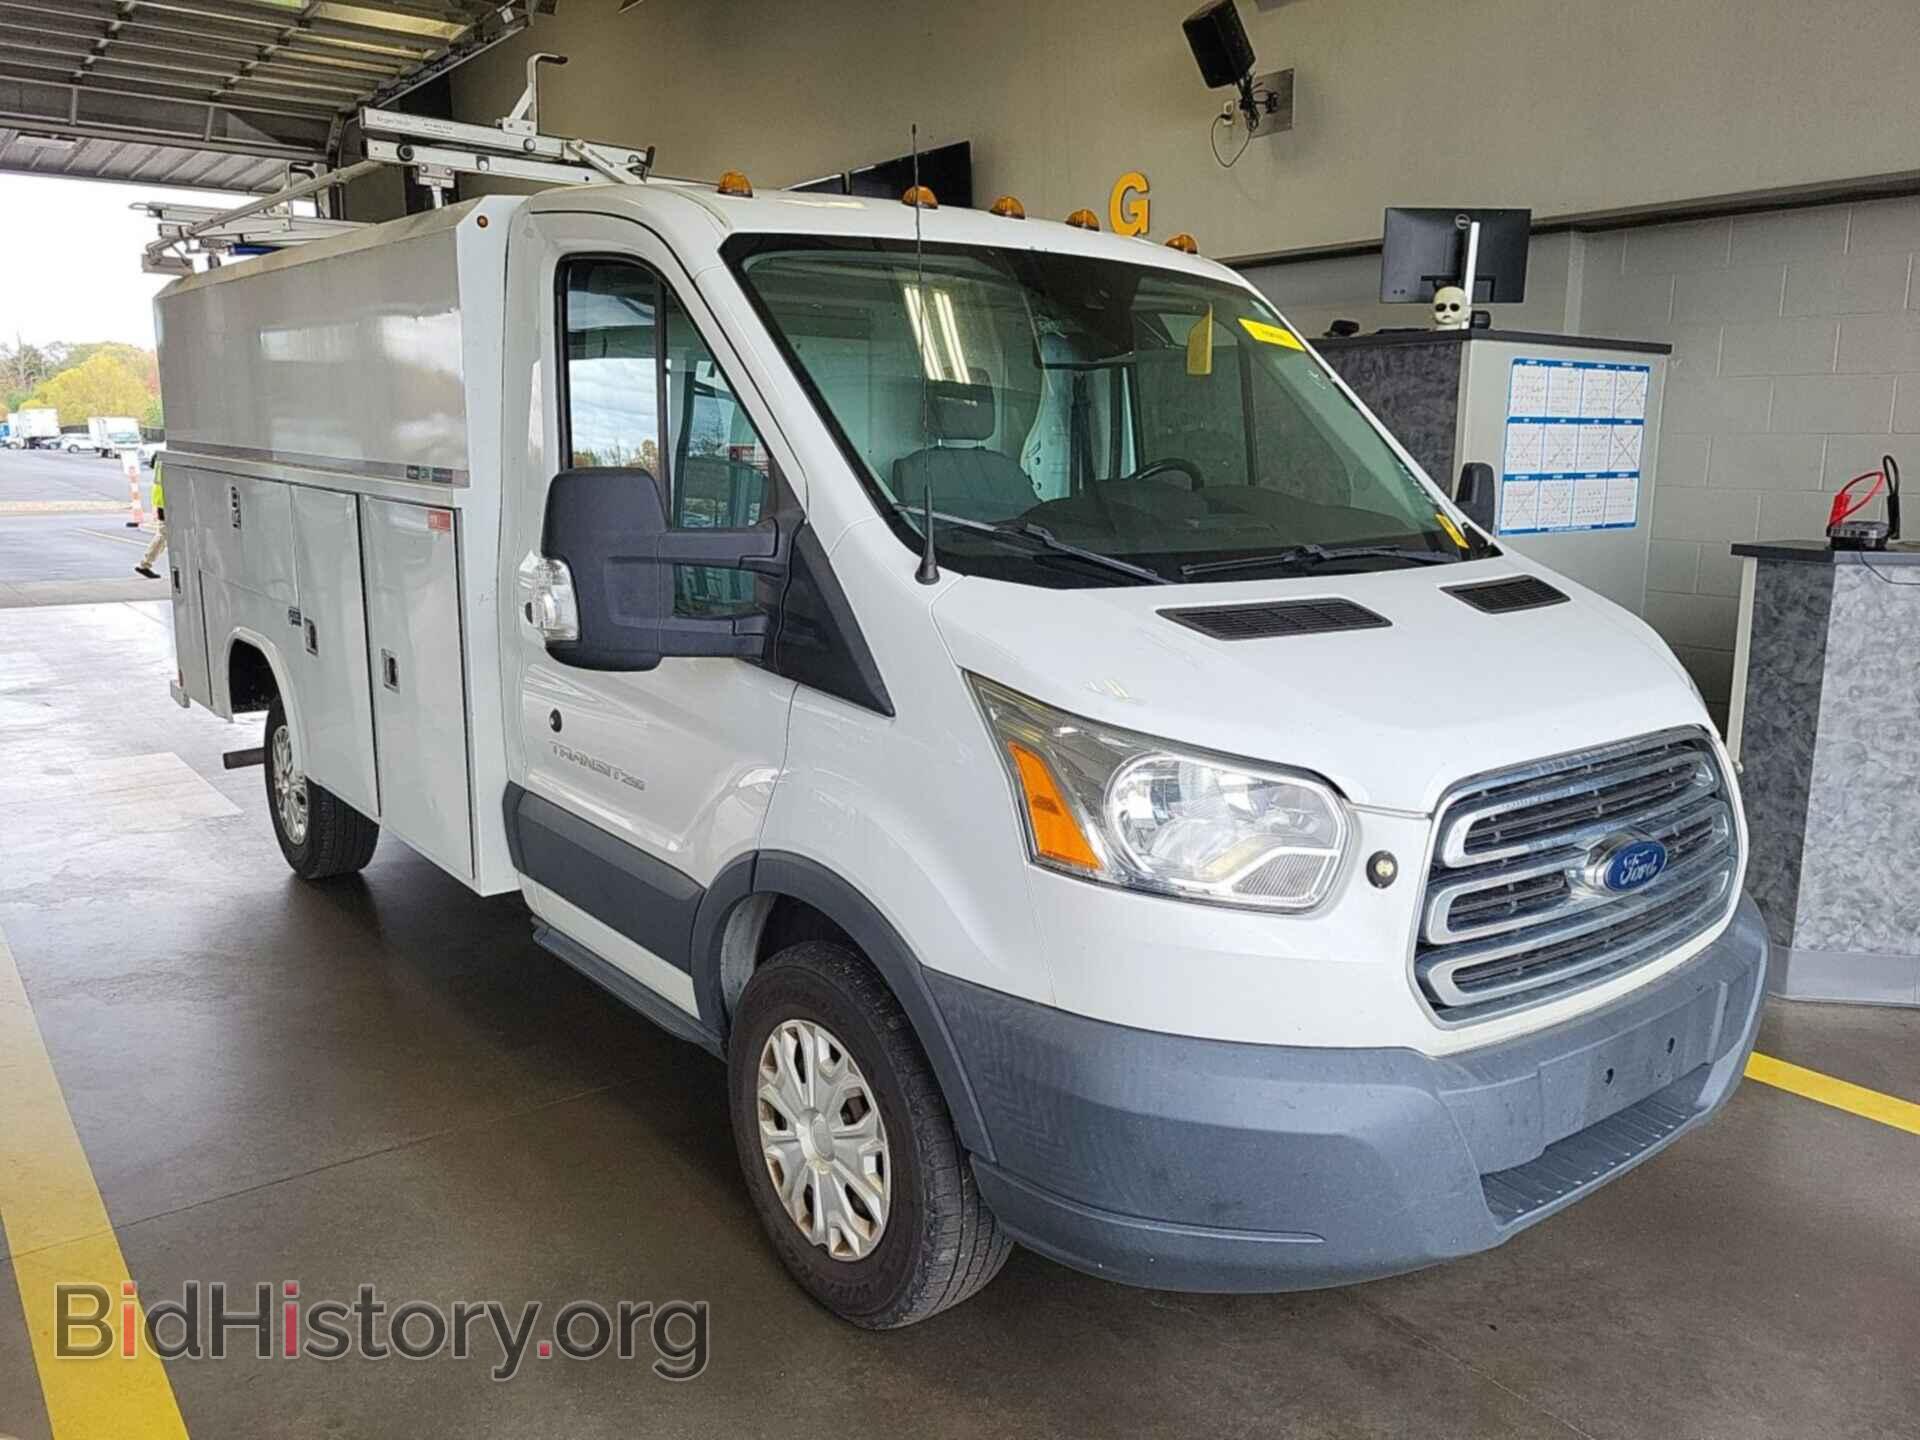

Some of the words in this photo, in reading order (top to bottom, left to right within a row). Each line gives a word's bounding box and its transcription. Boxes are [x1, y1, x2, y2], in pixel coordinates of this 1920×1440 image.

[1109, 171, 1150, 236] G
[548, 739, 624, 780] TRANSIT
[1619, 849, 1658, 885] Ford
